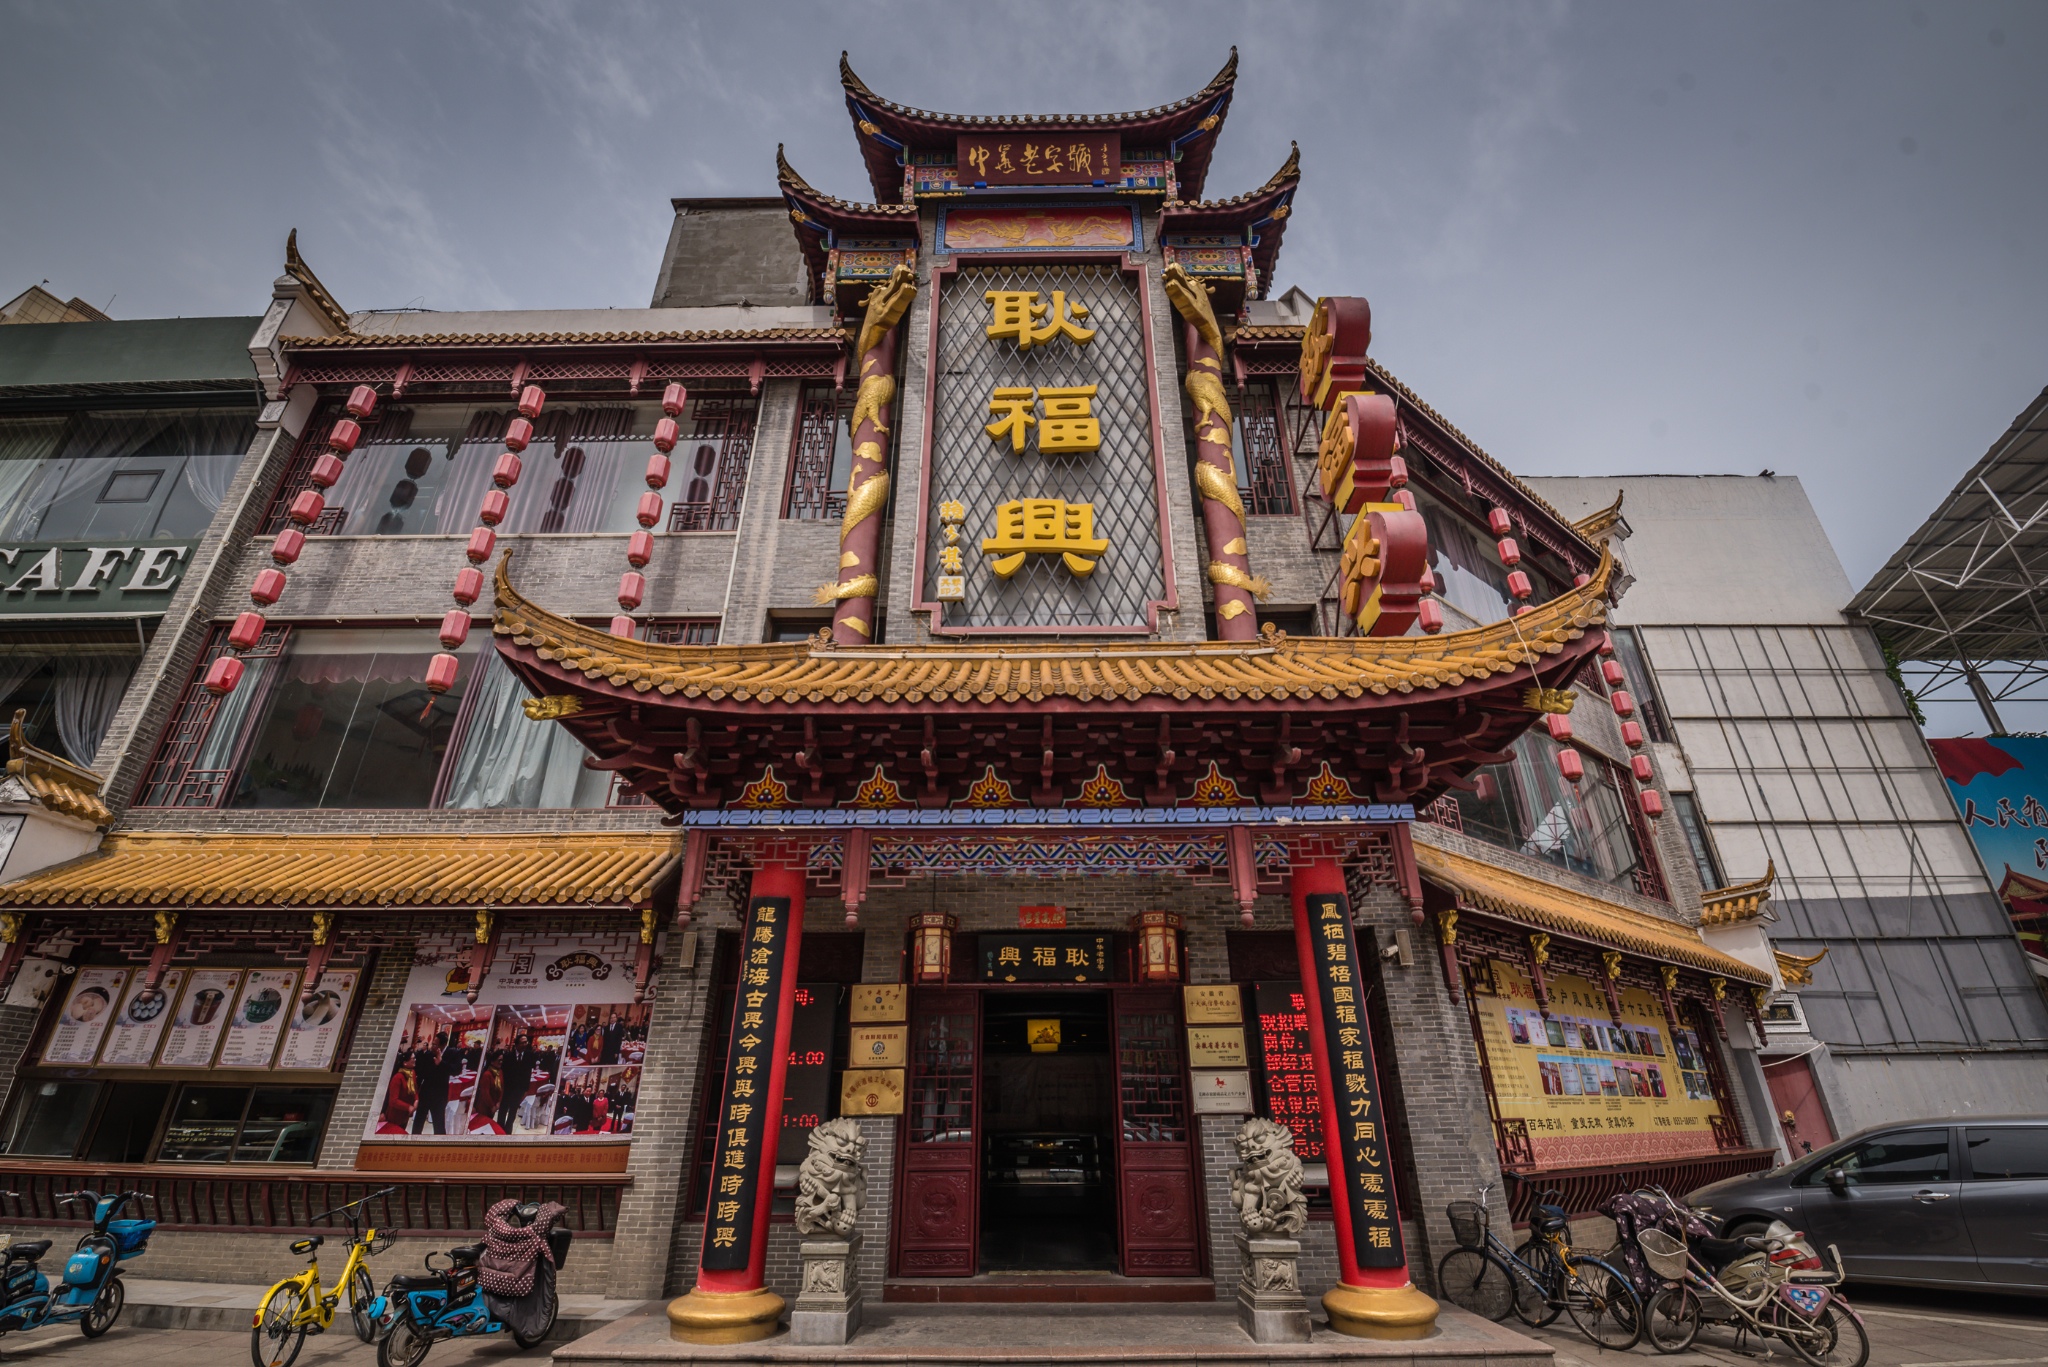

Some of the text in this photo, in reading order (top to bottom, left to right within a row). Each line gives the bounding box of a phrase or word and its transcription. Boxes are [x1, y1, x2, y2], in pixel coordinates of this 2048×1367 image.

[982, 290, 1109, 579] 耿福興
[1024, 911, 1064, 925] 吉星高照
[560, 954, 598, 969] 耿福興
[999, 946, 1090, 967] 耿福興
[1096, 938, 1105, 972] 中华老字号
